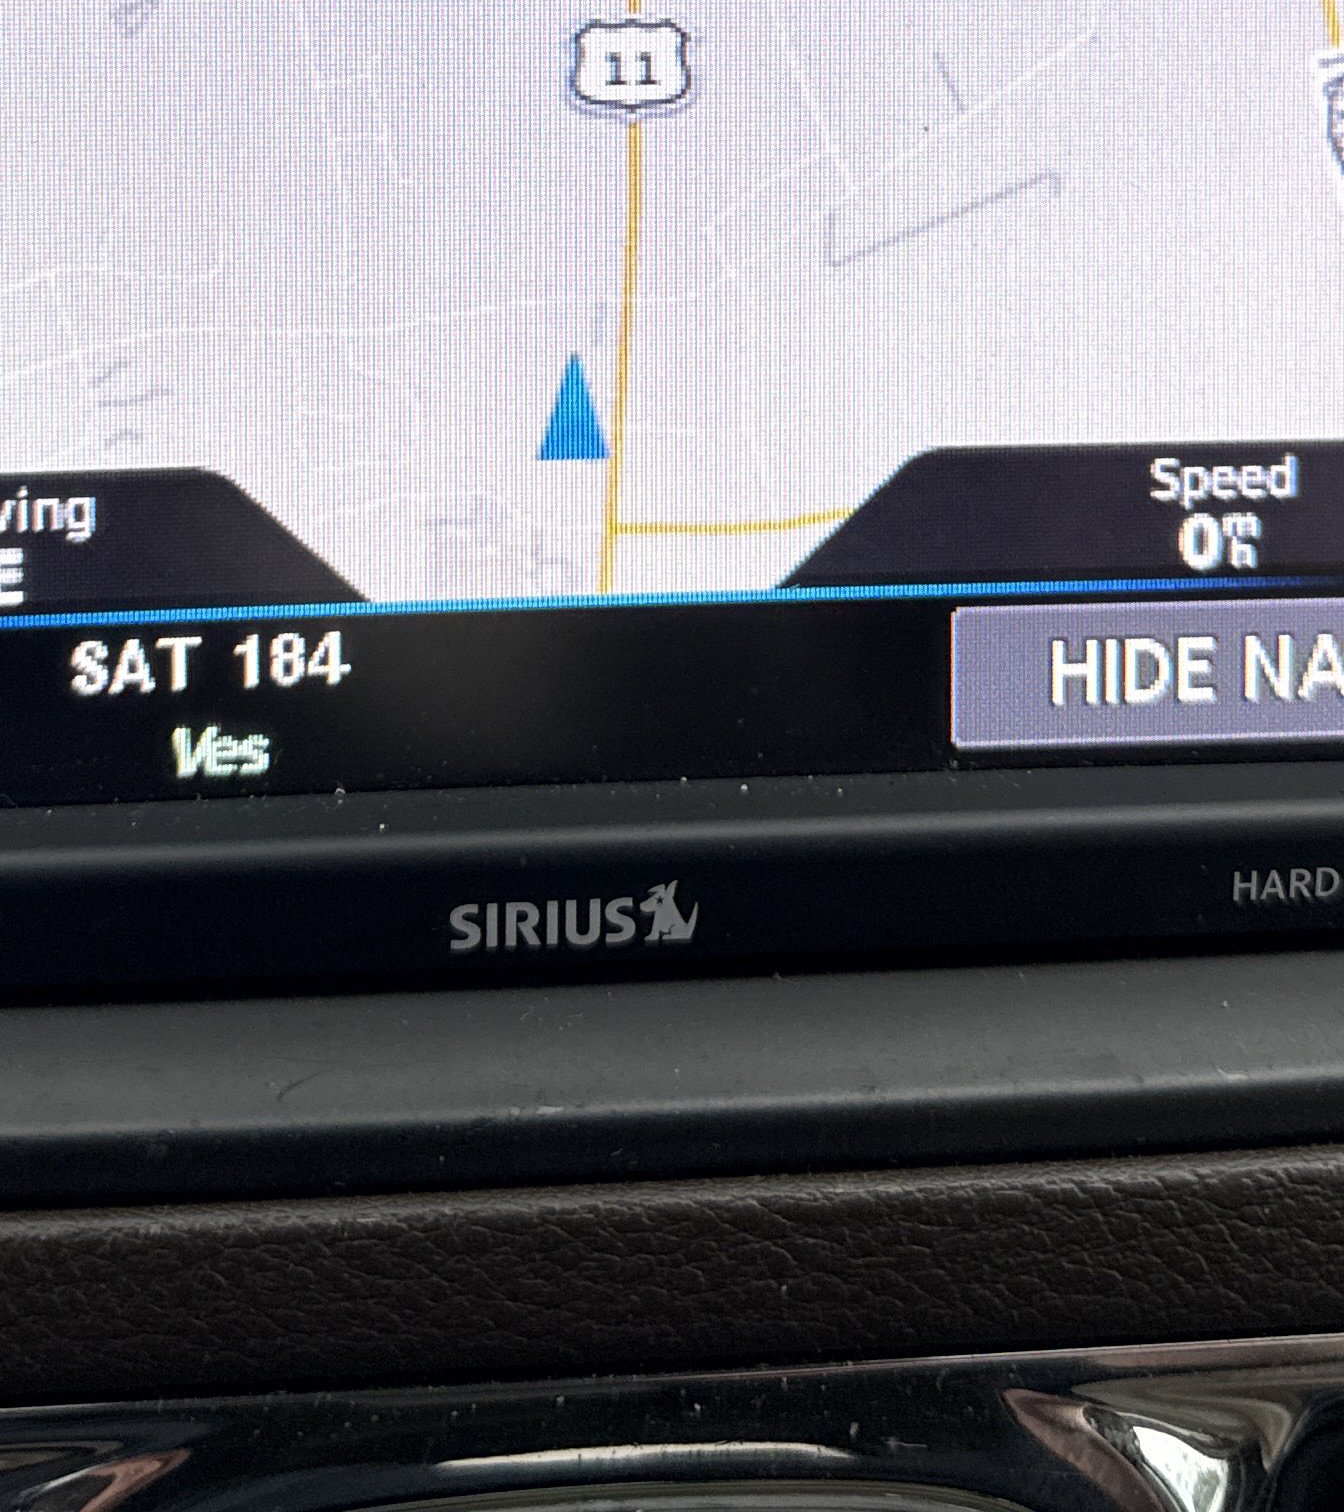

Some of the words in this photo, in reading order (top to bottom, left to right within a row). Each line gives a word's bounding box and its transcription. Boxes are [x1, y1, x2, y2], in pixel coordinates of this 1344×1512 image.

[604, 51, 659, 85] 11
[1150, 452, 1299, 510] Speed
[70, 635, 204, 696] SAT
[234, 631, 352, 689] 184
[1050, 636, 1219, 705] HIDE
[1232, 866, 1342, 902] HARD
[448, 895, 638, 951] SIRIUS
